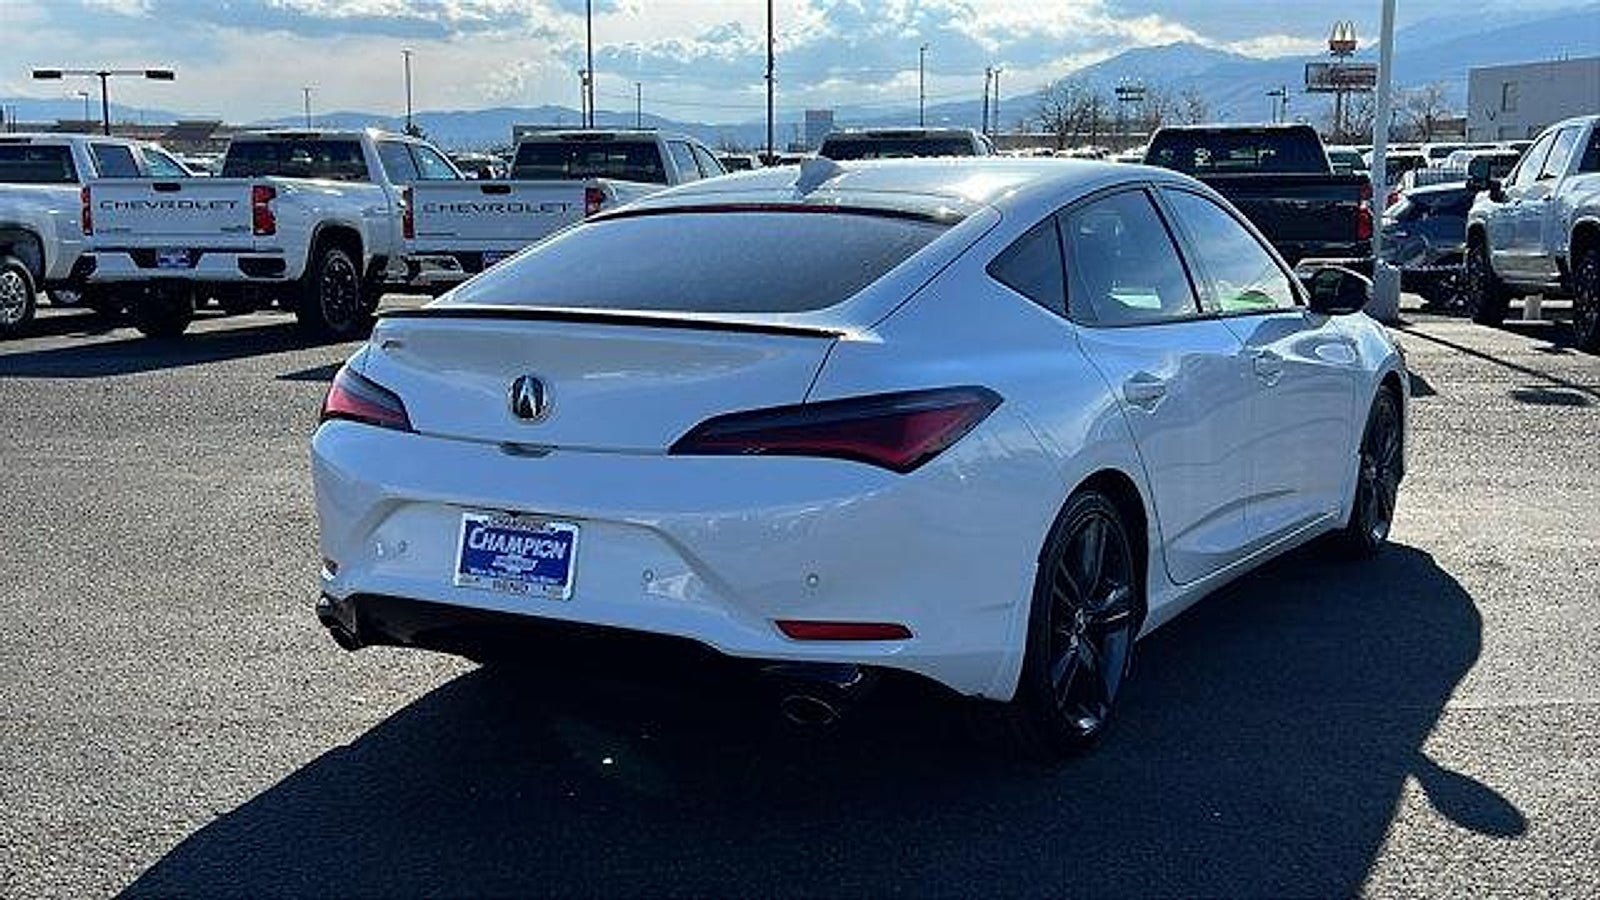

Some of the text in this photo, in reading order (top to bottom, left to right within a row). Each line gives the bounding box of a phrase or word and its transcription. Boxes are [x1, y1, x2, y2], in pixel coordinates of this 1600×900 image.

[100, 200, 238, 209] CHEVROLET
[423, 202, 571, 213] CHEVROLET
[468, 527, 567, 559] CHAMPION
